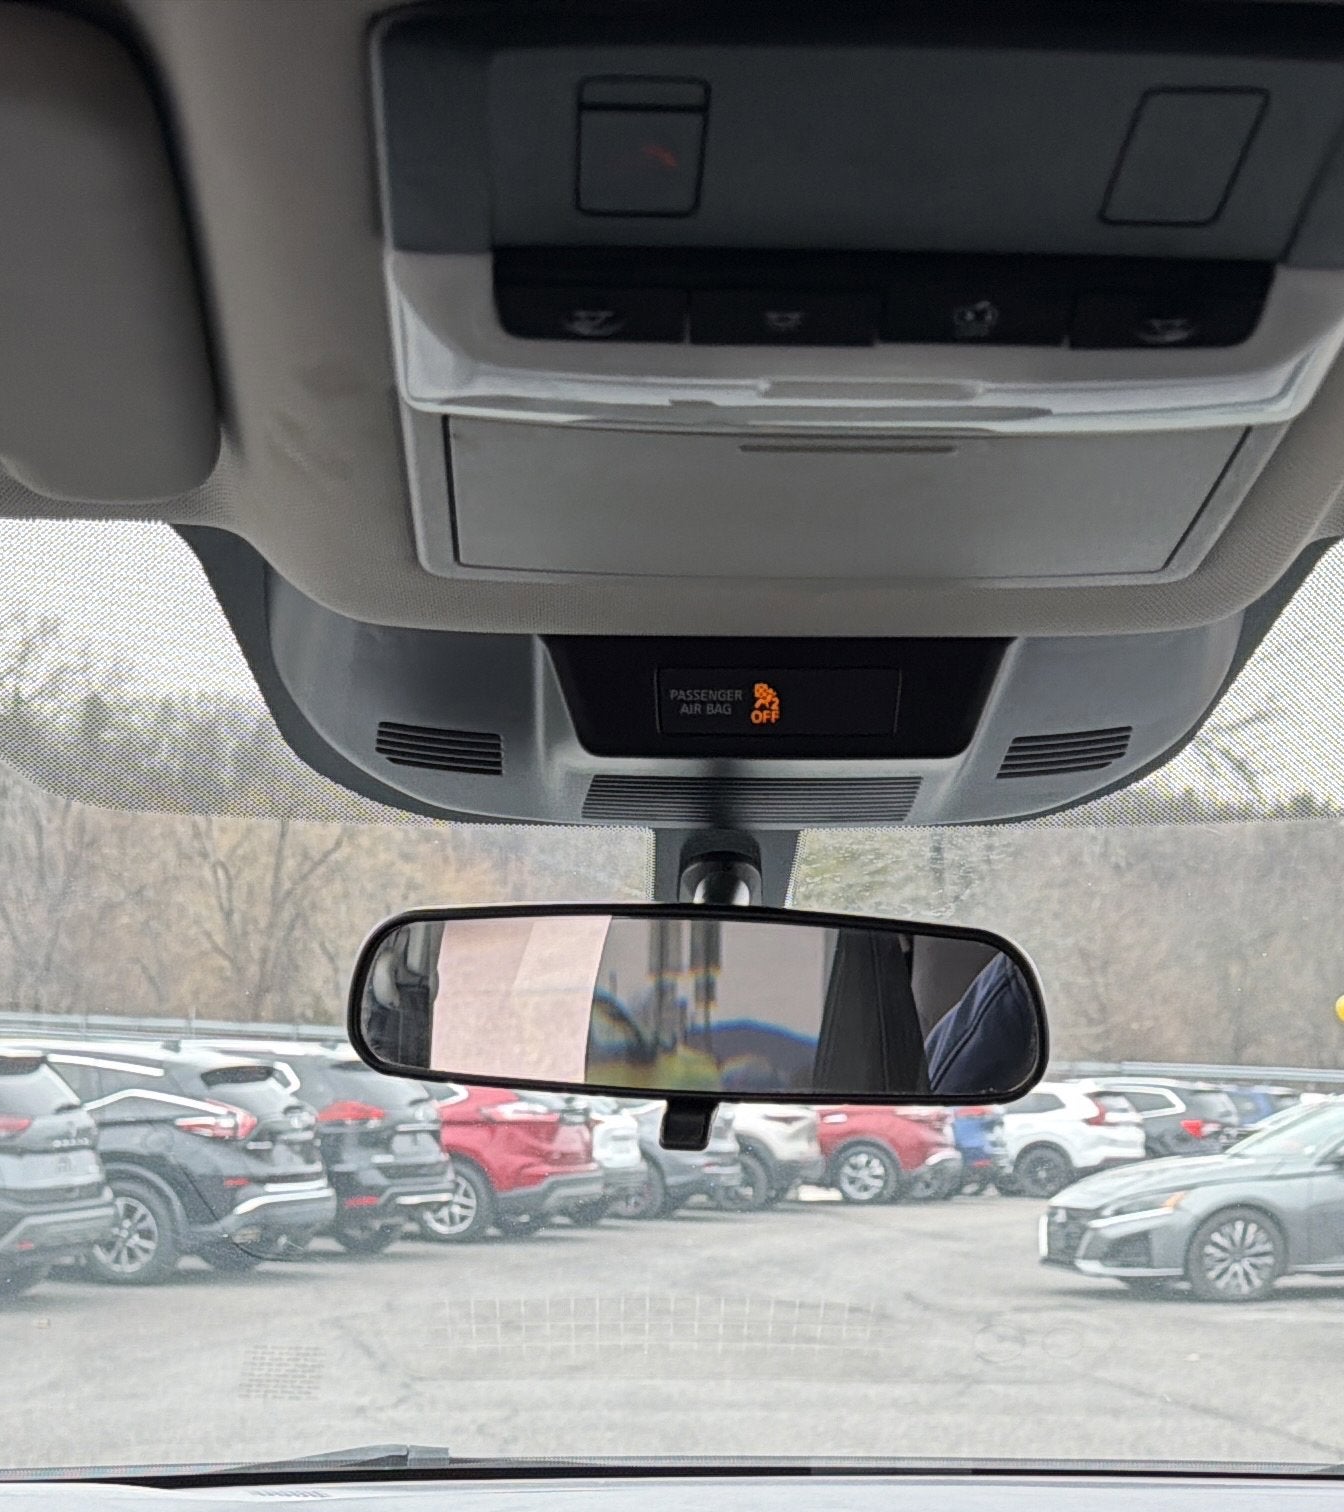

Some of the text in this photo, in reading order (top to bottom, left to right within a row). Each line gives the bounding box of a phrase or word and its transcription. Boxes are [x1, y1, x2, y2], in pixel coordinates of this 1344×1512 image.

[670, 689, 743, 701] PASSENGER
[680, 703, 732, 715] AIR BAG
[750, 710, 780, 724] OFF
